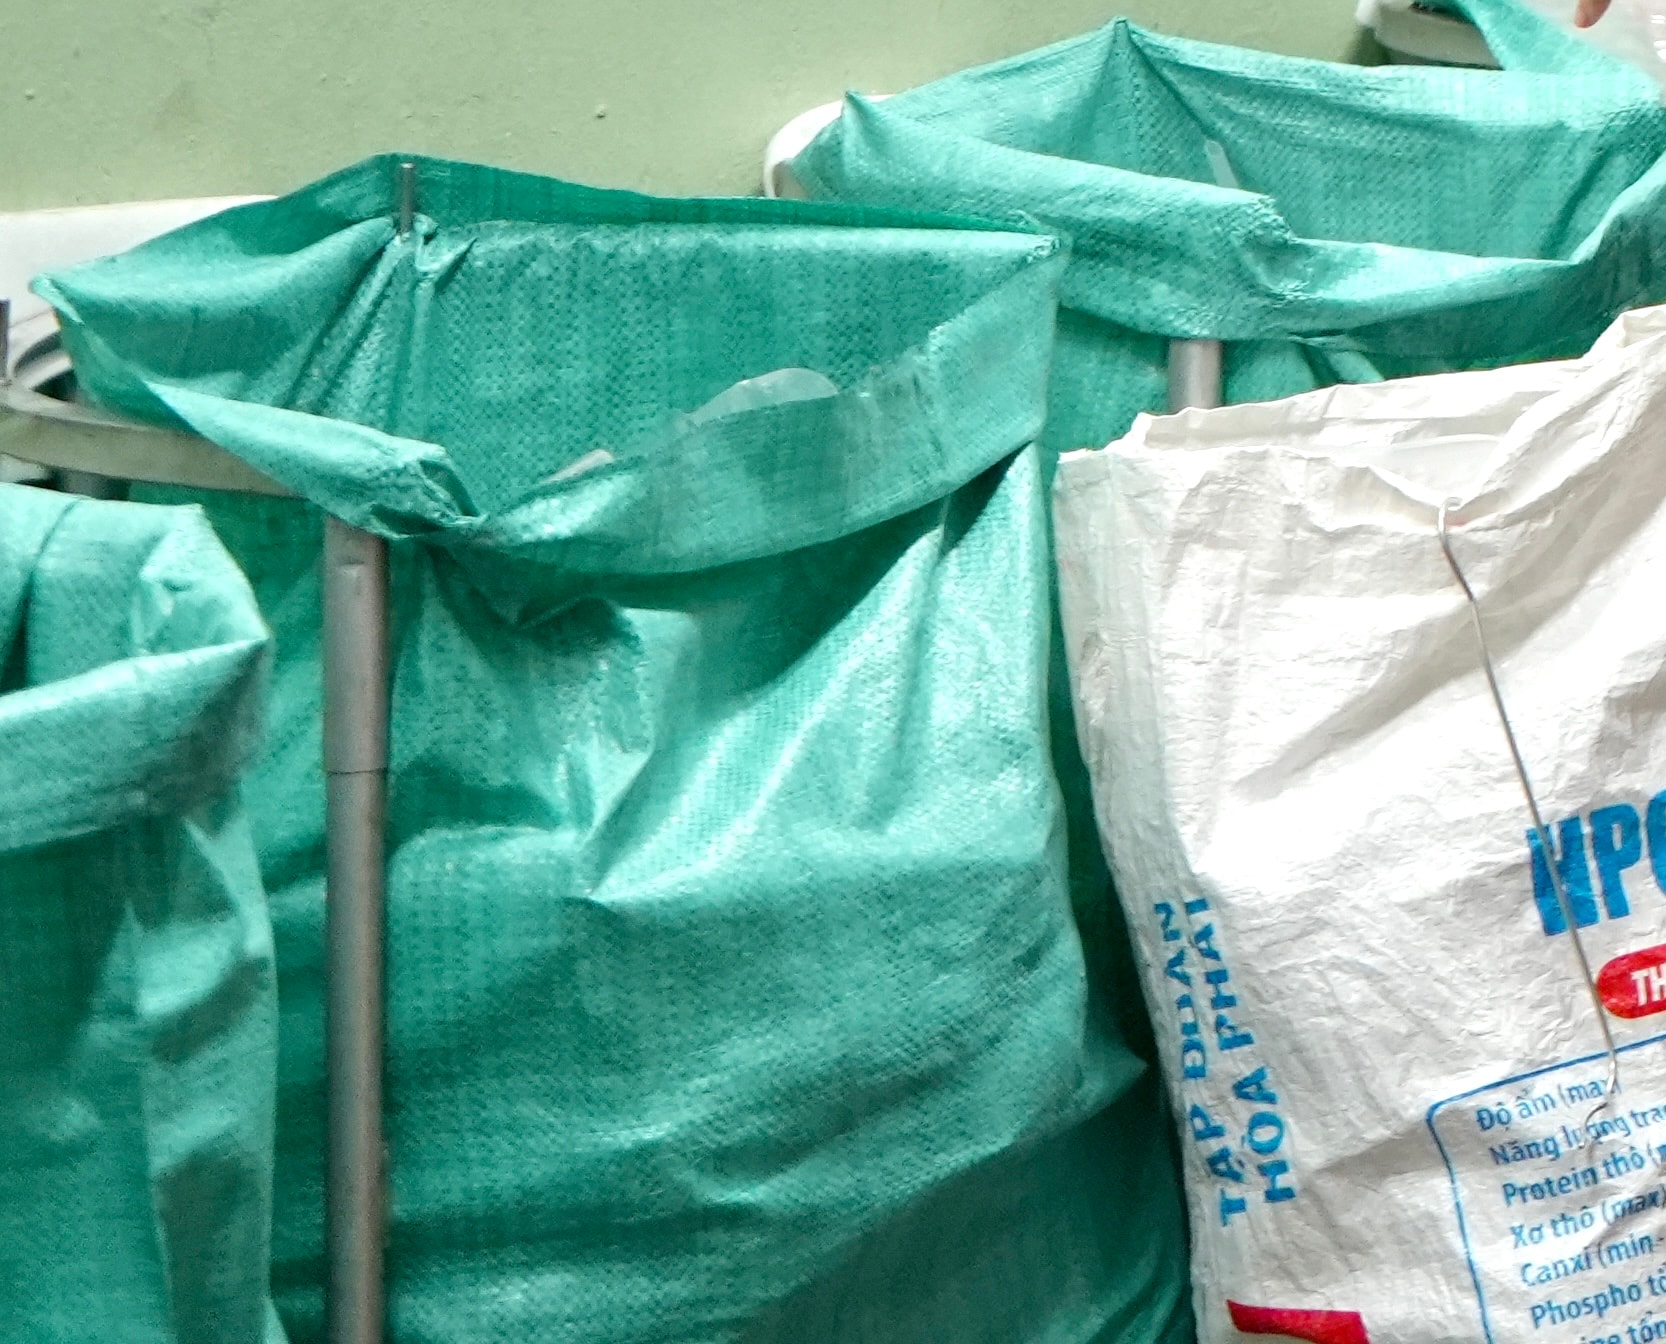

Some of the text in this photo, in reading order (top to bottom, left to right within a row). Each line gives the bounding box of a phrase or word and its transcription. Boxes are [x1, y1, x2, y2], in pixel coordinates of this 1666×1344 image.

[1476, 1100, 1512, 1131] Độ
[1488, 1136, 1562, 1166] Năng
[1502, 1164, 1600, 1206] Protein
[1602, 1145, 1645, 1177] thô
[1510, 1220, 1543, 1249] Xơ
[1550, 1205, 1594, 1238] thô
[1520, 1248, 1591, 1287] Canxi
[1529, 1283, 1642, 1330] Phospho
